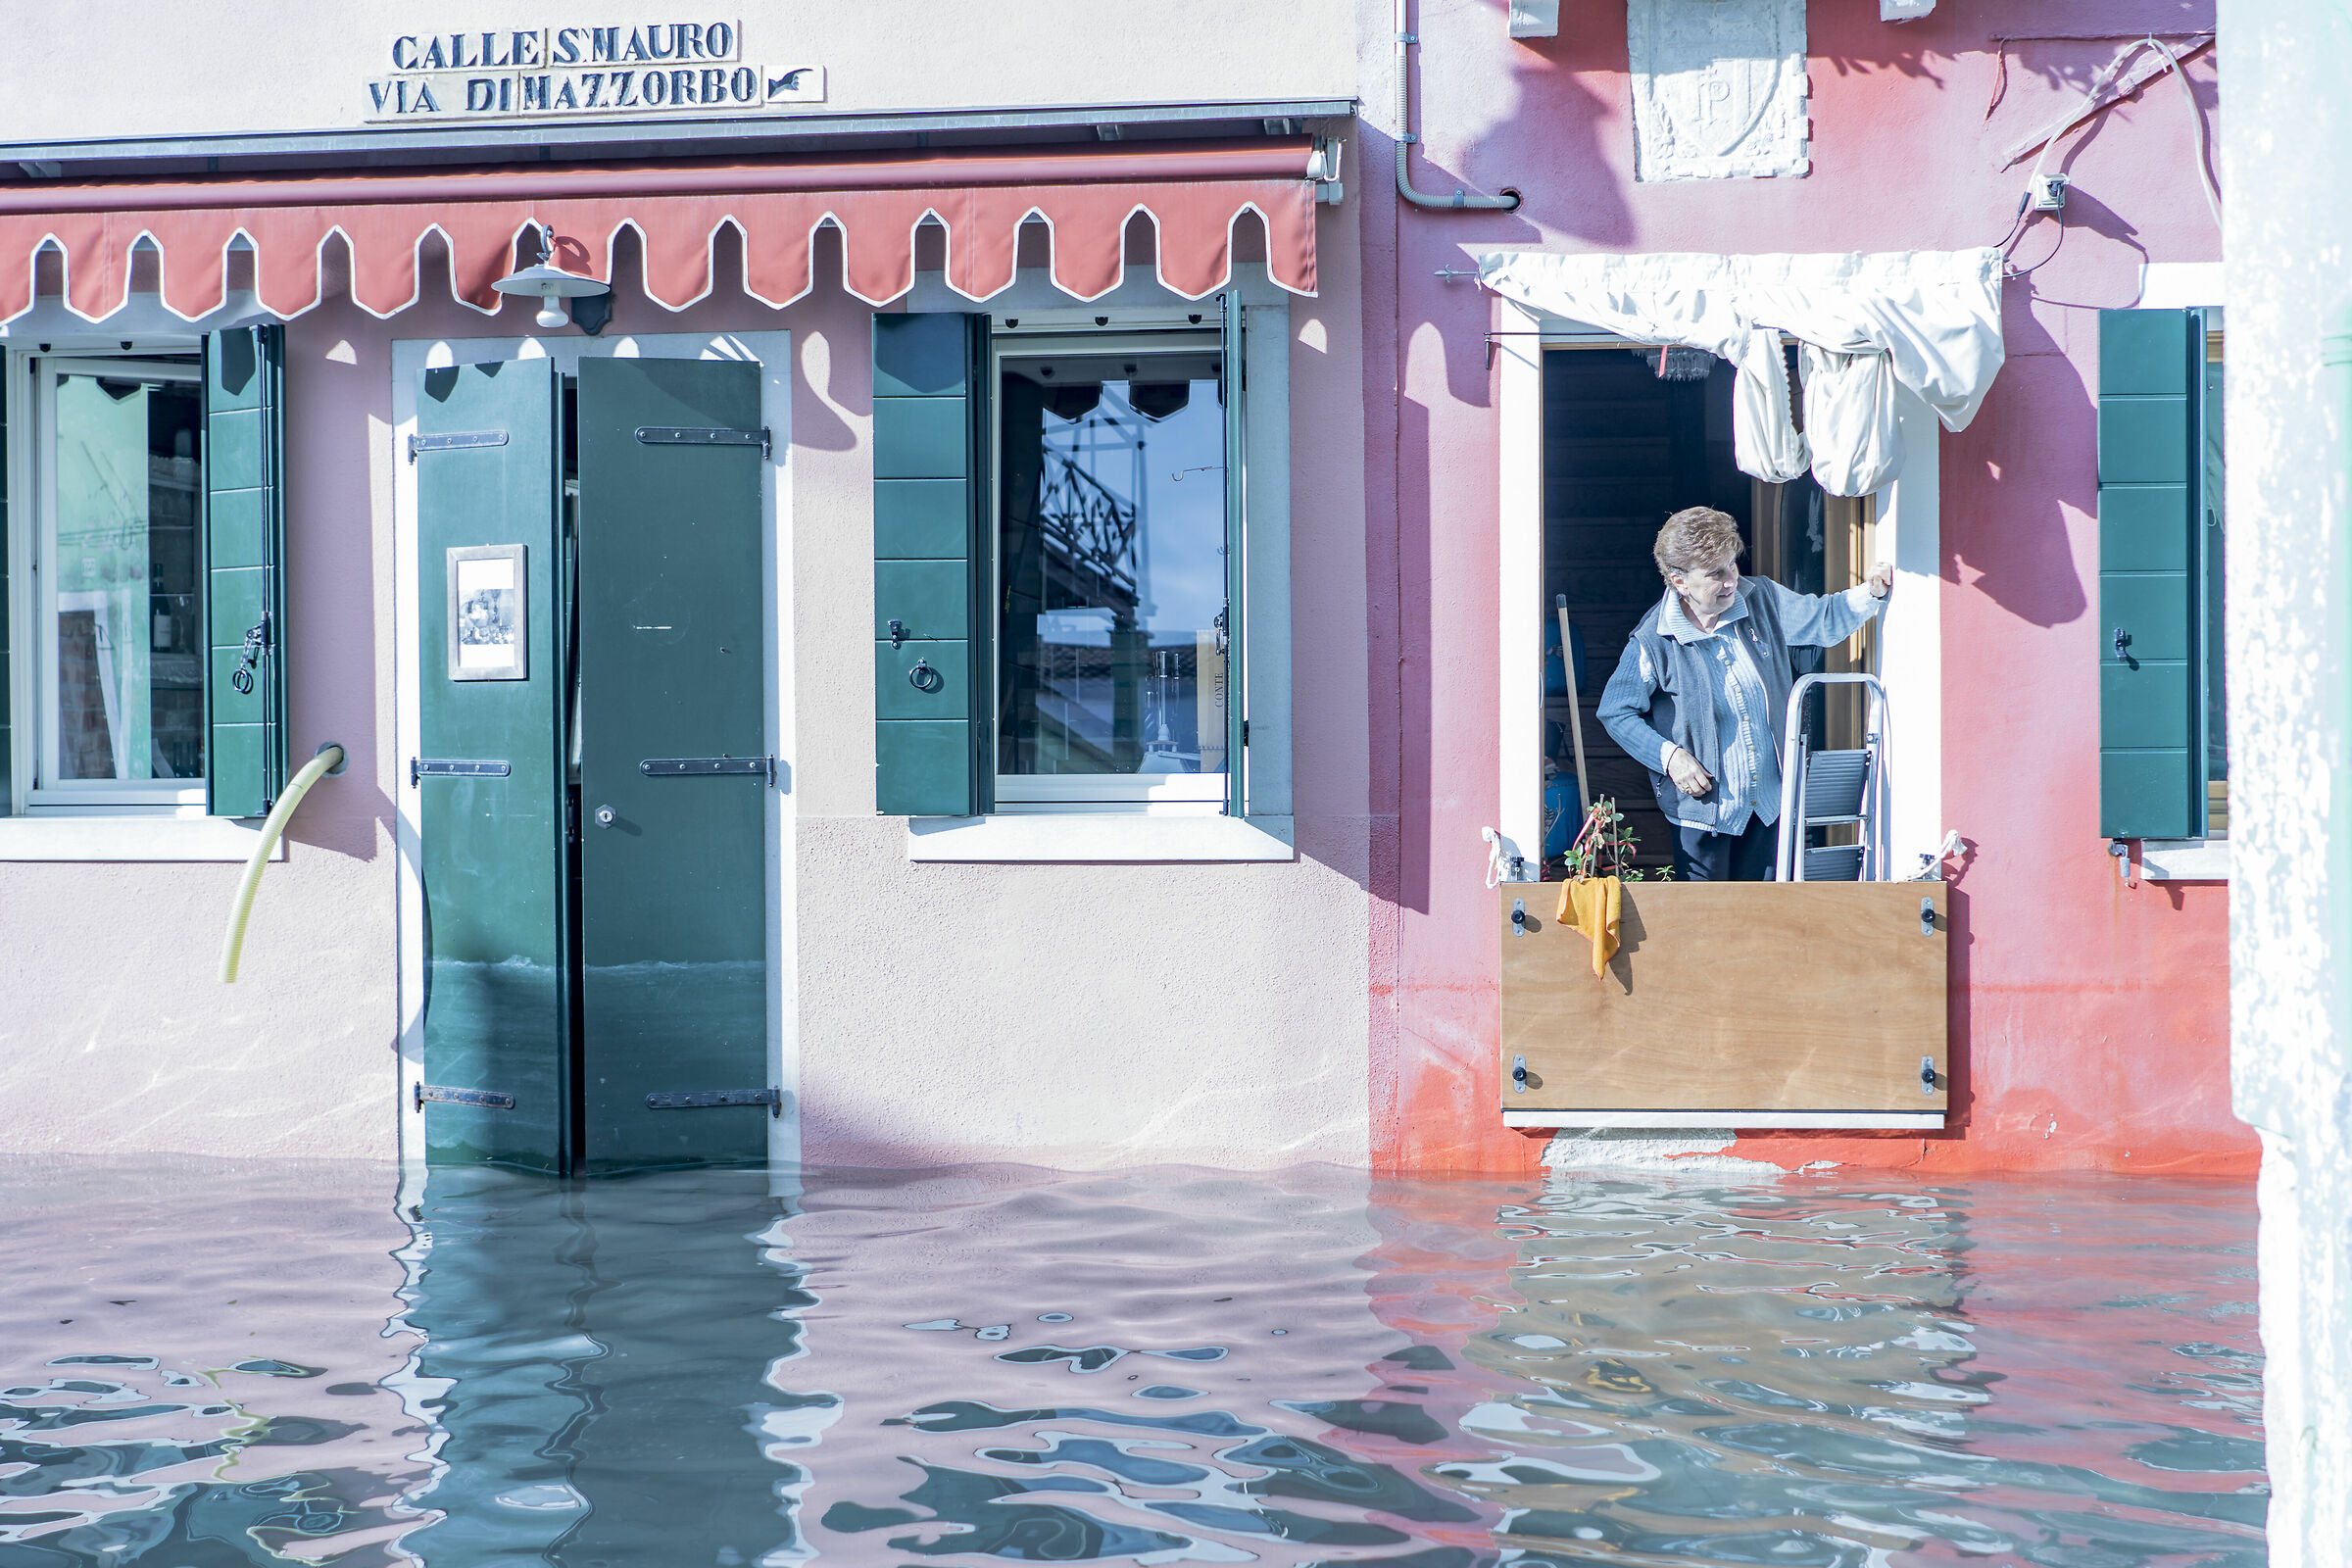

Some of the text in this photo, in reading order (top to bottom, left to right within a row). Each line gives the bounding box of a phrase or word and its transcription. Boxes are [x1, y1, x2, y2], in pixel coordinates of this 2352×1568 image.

[393, 30, 539, 69] CALLE
[369, 68, 758, 114] VIA DI MAZZORBO
[1215, 673, 1224, 708] CONTE
